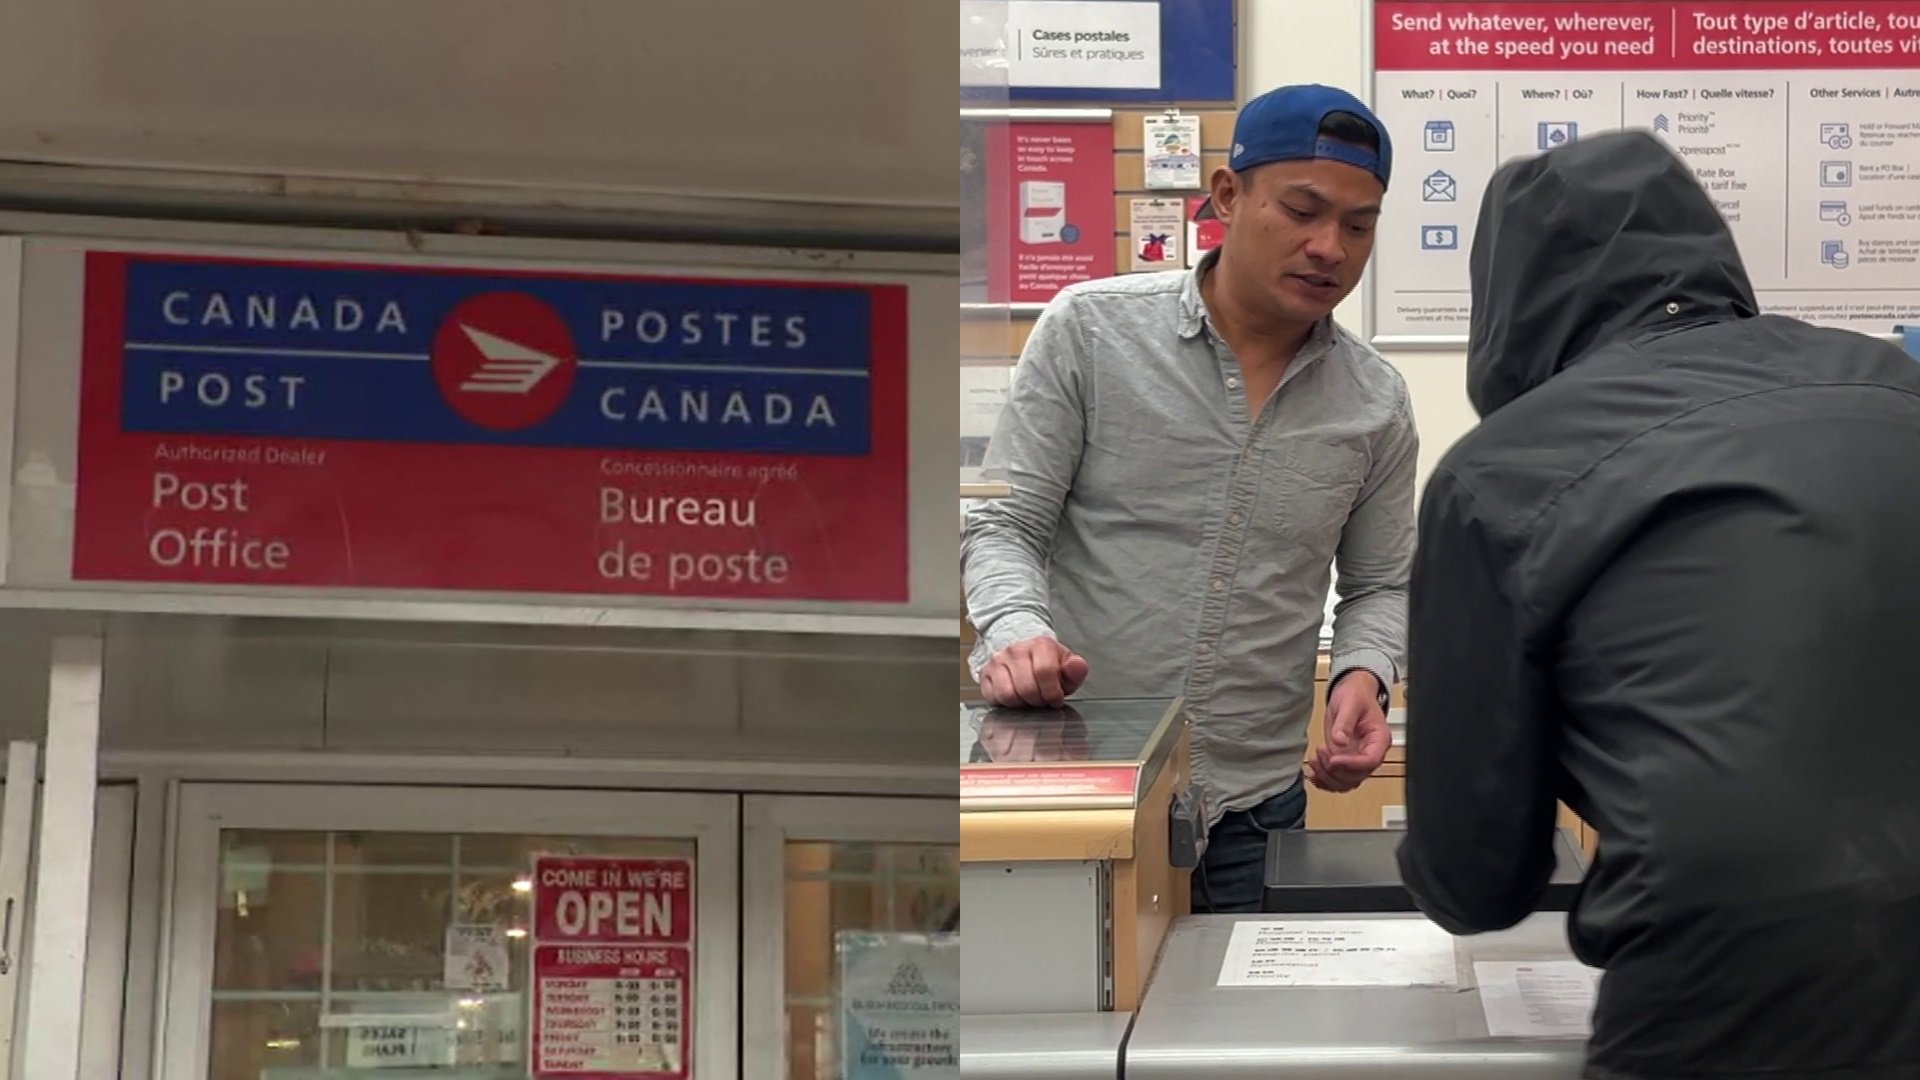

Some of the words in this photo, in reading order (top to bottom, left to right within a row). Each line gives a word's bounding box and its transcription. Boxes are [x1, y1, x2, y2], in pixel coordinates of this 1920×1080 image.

[1391, 13, 1441, 31] Send
[1447, 13, 1548, 33] whatever,
[1554, 12, 1655, 33] wherever,
[1692, 12, 1738, 30] Tout
[1742, 14, 1789, 35] type
[1794, 11, 1880, 32] d'article,
[1032, 29, 1072, 42] Cases
[1075, 30, 1131, 44] postales
[1692, 36, 1822, 55] destinations,
[1828, 37, 1893, 54] toutes
[1032, 46, 1066, 59] Sûres
[1070, 49, 1084, 59] et
[1086, 48, 1145, 62] pratiques
[1429, 38, 1450, 54] at
[1455, 37, 1489, 54] the
[1495, 37, 1554, 58] speed
[1560, 40, 1598, 59] you
[1604, 37, 1655, 54] need
[1401, 89, 1434, 100] What?
[1446, 89, 1477, 100] Quoi?
[1521, 89, 1560, 100] Where?
[1572, 88, 1593, 100] Où?
[1636, 89, 1660, 99] How
[1662, 89, 1688, 99] Fast?
[1700, 89, 1732, 100] Quelle
[1734, 89, 1775, 99] vitesse?
[1809, 88, 1839, 99] Other
[1840, 88, 1881, 98] Services
[1696, 168, 1716, 177] Rate
[1718, 168, 1735, 177] Box
[1711, 180, 1729, 190] tarif
[1730, 180, 1747, 190] fixe
[162, 290, 408, 336] CANADA
[600, 310, 809, 349] POSTES
[160, 370, 306, 410] POST
[600, 388, 837, 429] CANADA
[155, 443, 260, 465] Authorized
[266, 446, 327, 467] Dealer
[600, 458, 743, 478] Concessionnaire
[748, 461, 798, 483] agréé
[152, 472, 249, 513] Post
[600, 487, 756, 528] Bureau
[149, 526, 290, 570] Office
[598, 541, 652, 581] de
[669, 551, 789, 591] poste
[541, 869, 597, 888] COME
[602, 869, 621, 888] IN
[628, 869, 686, 891] WE'RE
[556, 890, 673, 937] OPEN
[557, 948, 621, 965] BUSINESS
[622, 949, 669, 967] HOURS
